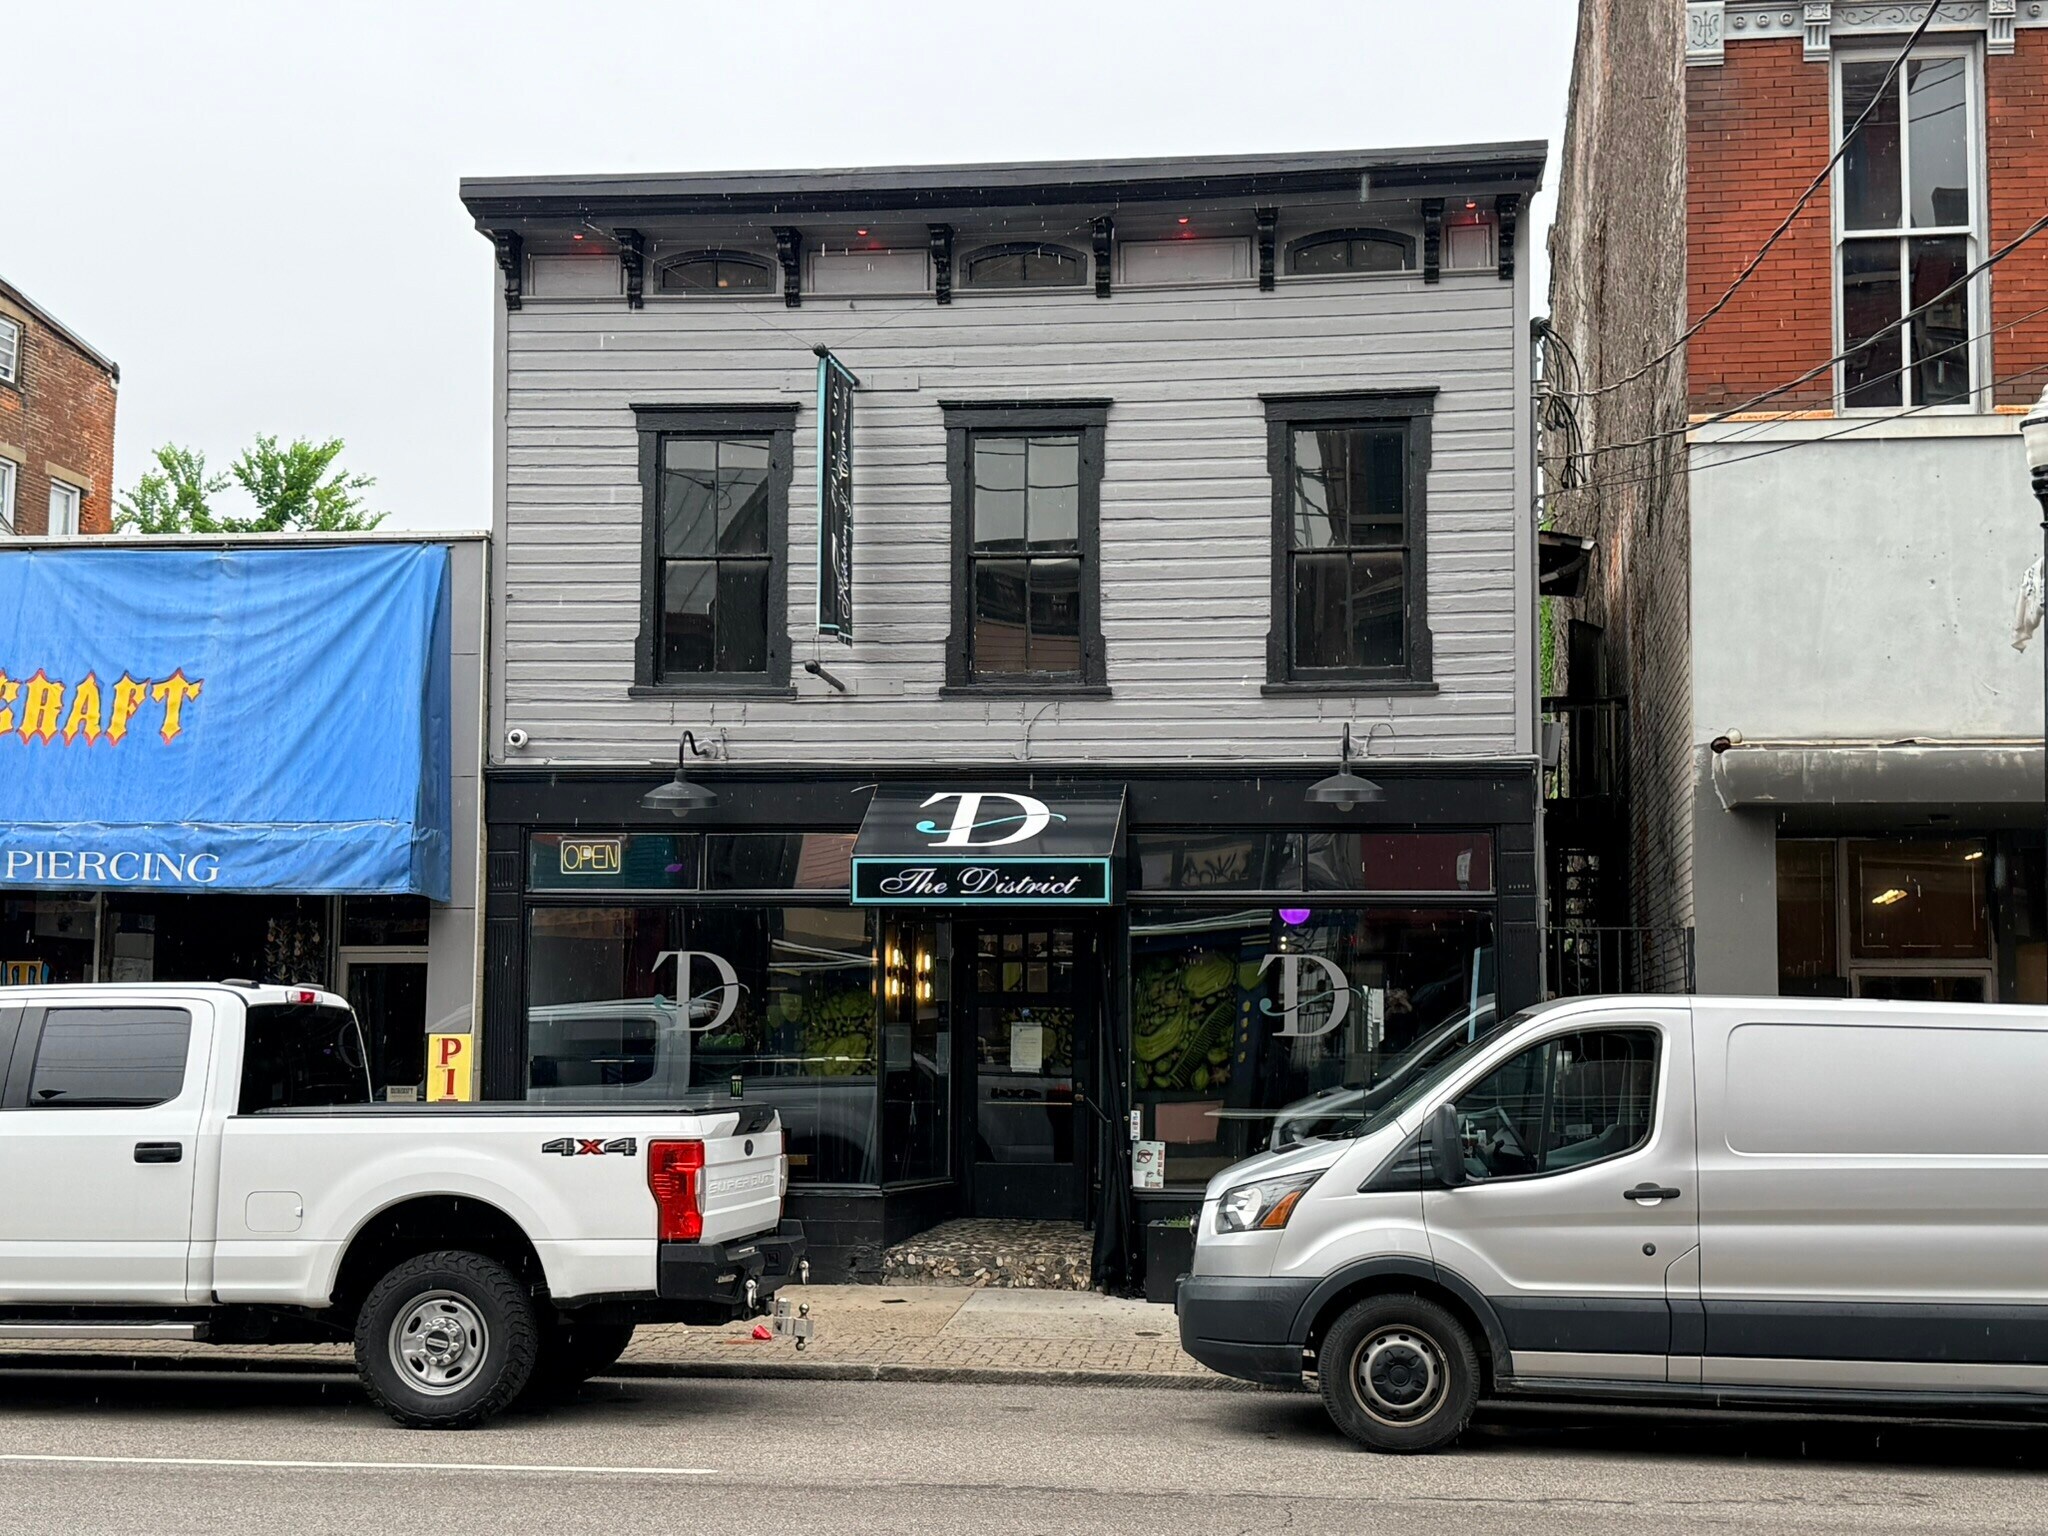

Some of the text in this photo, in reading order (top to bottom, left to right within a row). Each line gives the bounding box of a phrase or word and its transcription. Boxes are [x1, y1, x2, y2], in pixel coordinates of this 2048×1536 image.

[5, 850, 220, 883] PIERCING
[563, 845, 618, 869] OPEN
[880, 867, 1082, 895] The District
